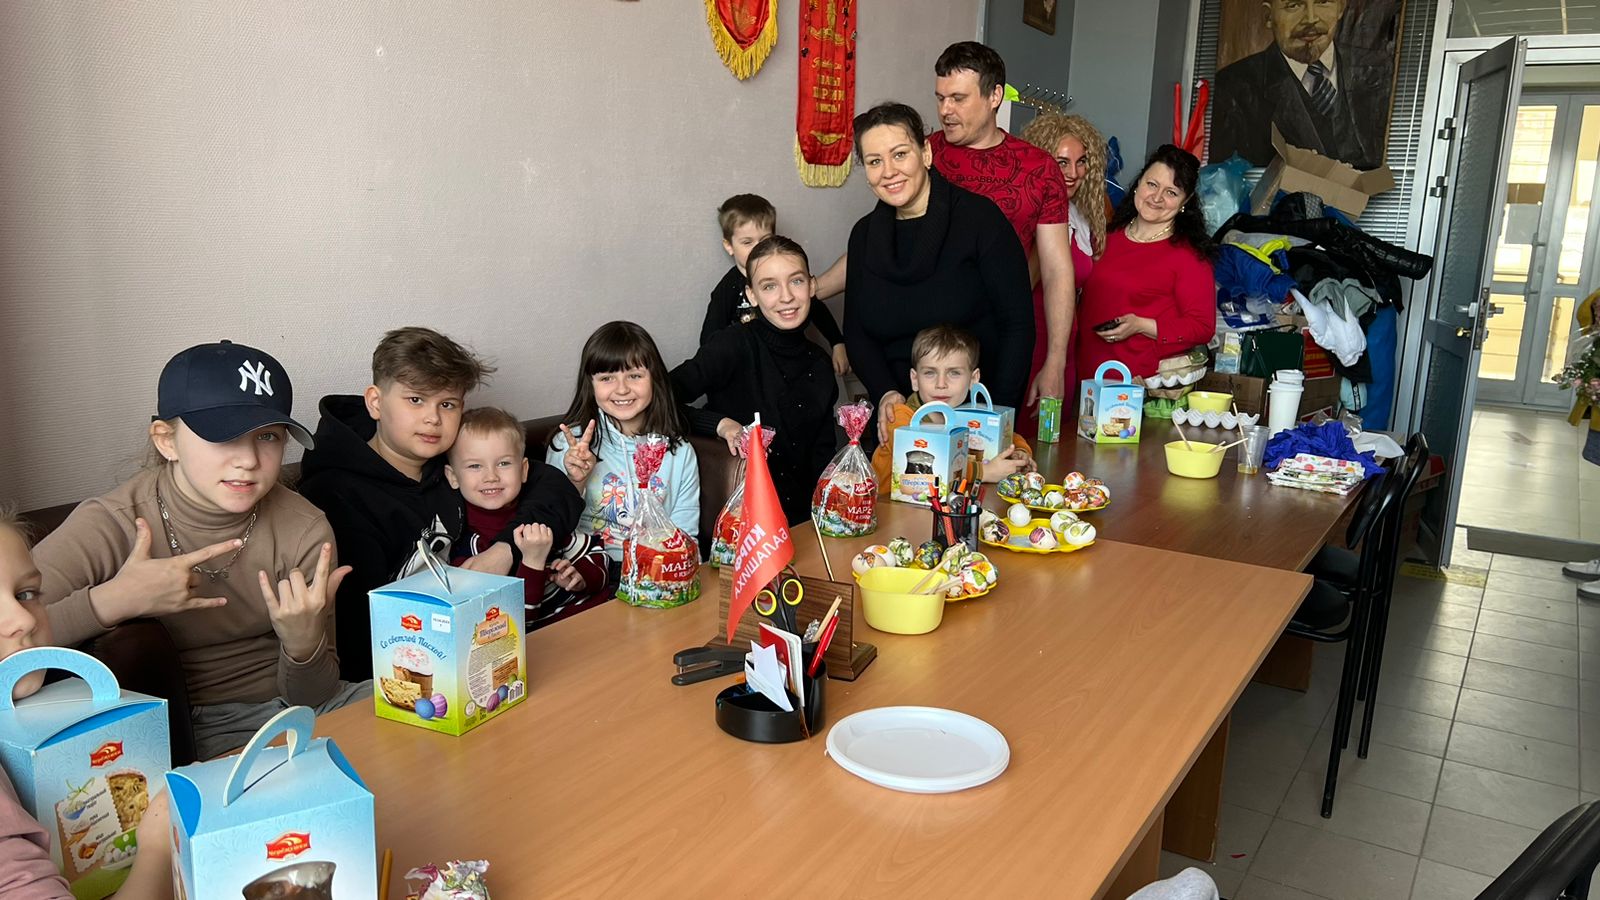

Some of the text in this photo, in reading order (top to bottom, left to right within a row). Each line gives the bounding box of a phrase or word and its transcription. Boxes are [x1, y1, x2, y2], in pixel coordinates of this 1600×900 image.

[237, 358, 275, 398] NY
[380, 635, 447, 660] Со светлой Пасхой!
